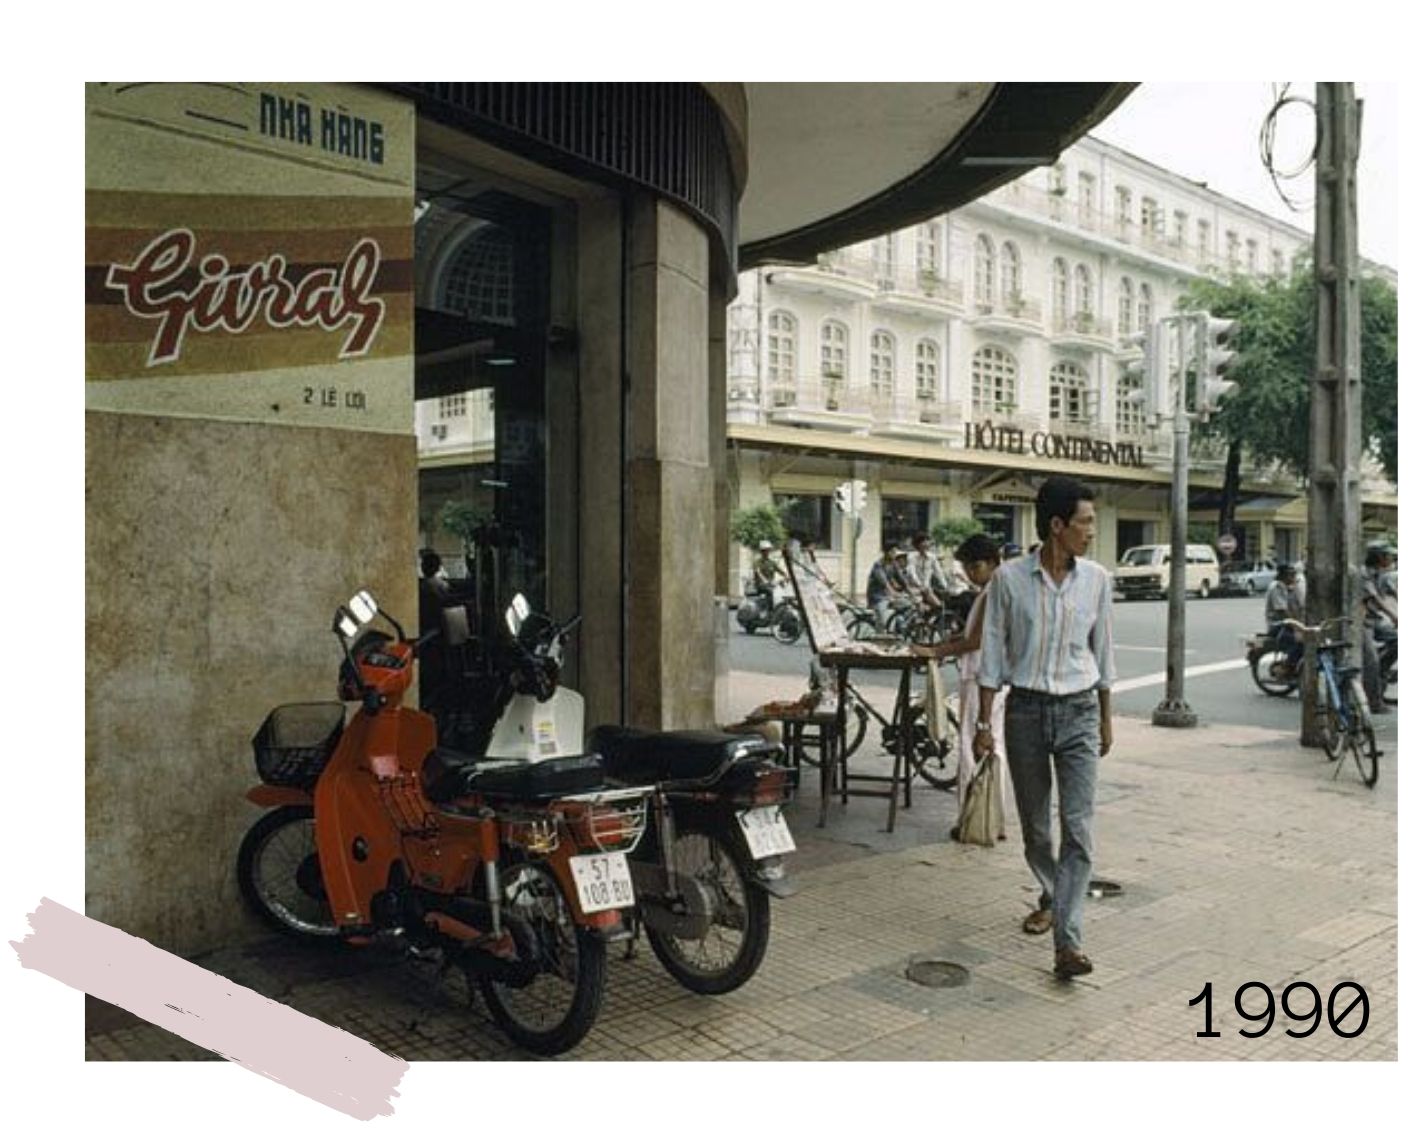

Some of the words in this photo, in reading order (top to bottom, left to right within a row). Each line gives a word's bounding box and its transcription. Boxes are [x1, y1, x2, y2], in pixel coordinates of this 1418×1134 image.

[105, 227, 385, 367] Givral
[304, 386, 313, 405] 2
[964, 419, 1024, 454] HÔTEL
[1031, 431, 1144, 468] CONTINENTAL
[590, 858, 609, 880] 57
